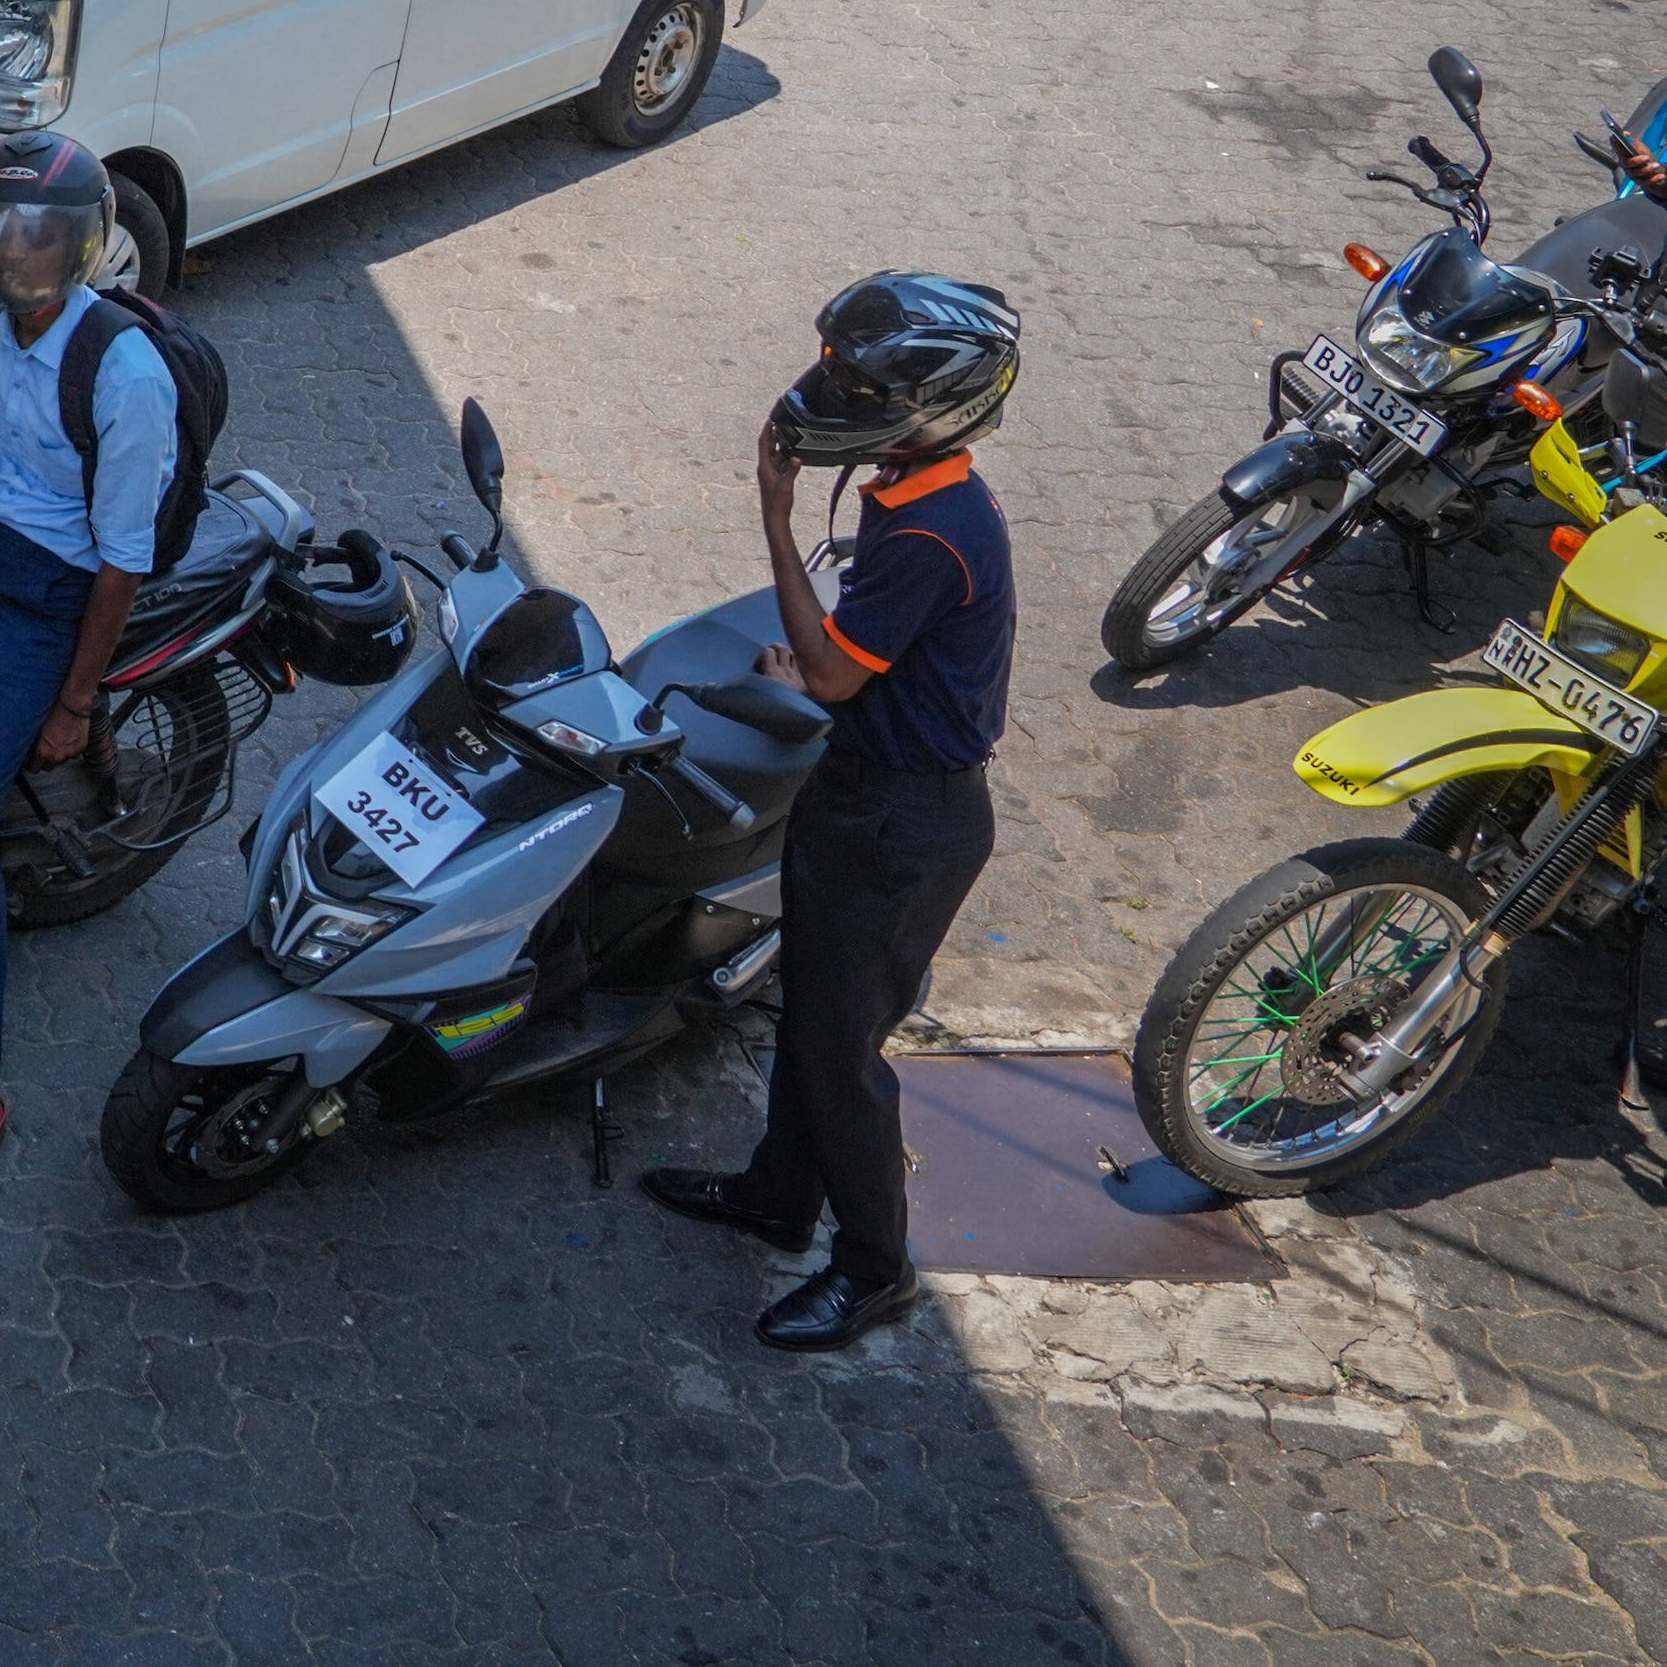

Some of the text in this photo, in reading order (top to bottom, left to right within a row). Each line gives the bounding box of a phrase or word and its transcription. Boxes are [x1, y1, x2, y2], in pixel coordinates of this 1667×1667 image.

[1362, 387, 1431, 445] 1321
[1512, 643, 1645, 744] HZ-0476
[455, 726, 490, 756] TVS
[381, 761, 450, 822] BKU
[1301, 752, 1361, 796] SUZUKI
[347, 790, 421, 854] 3427
